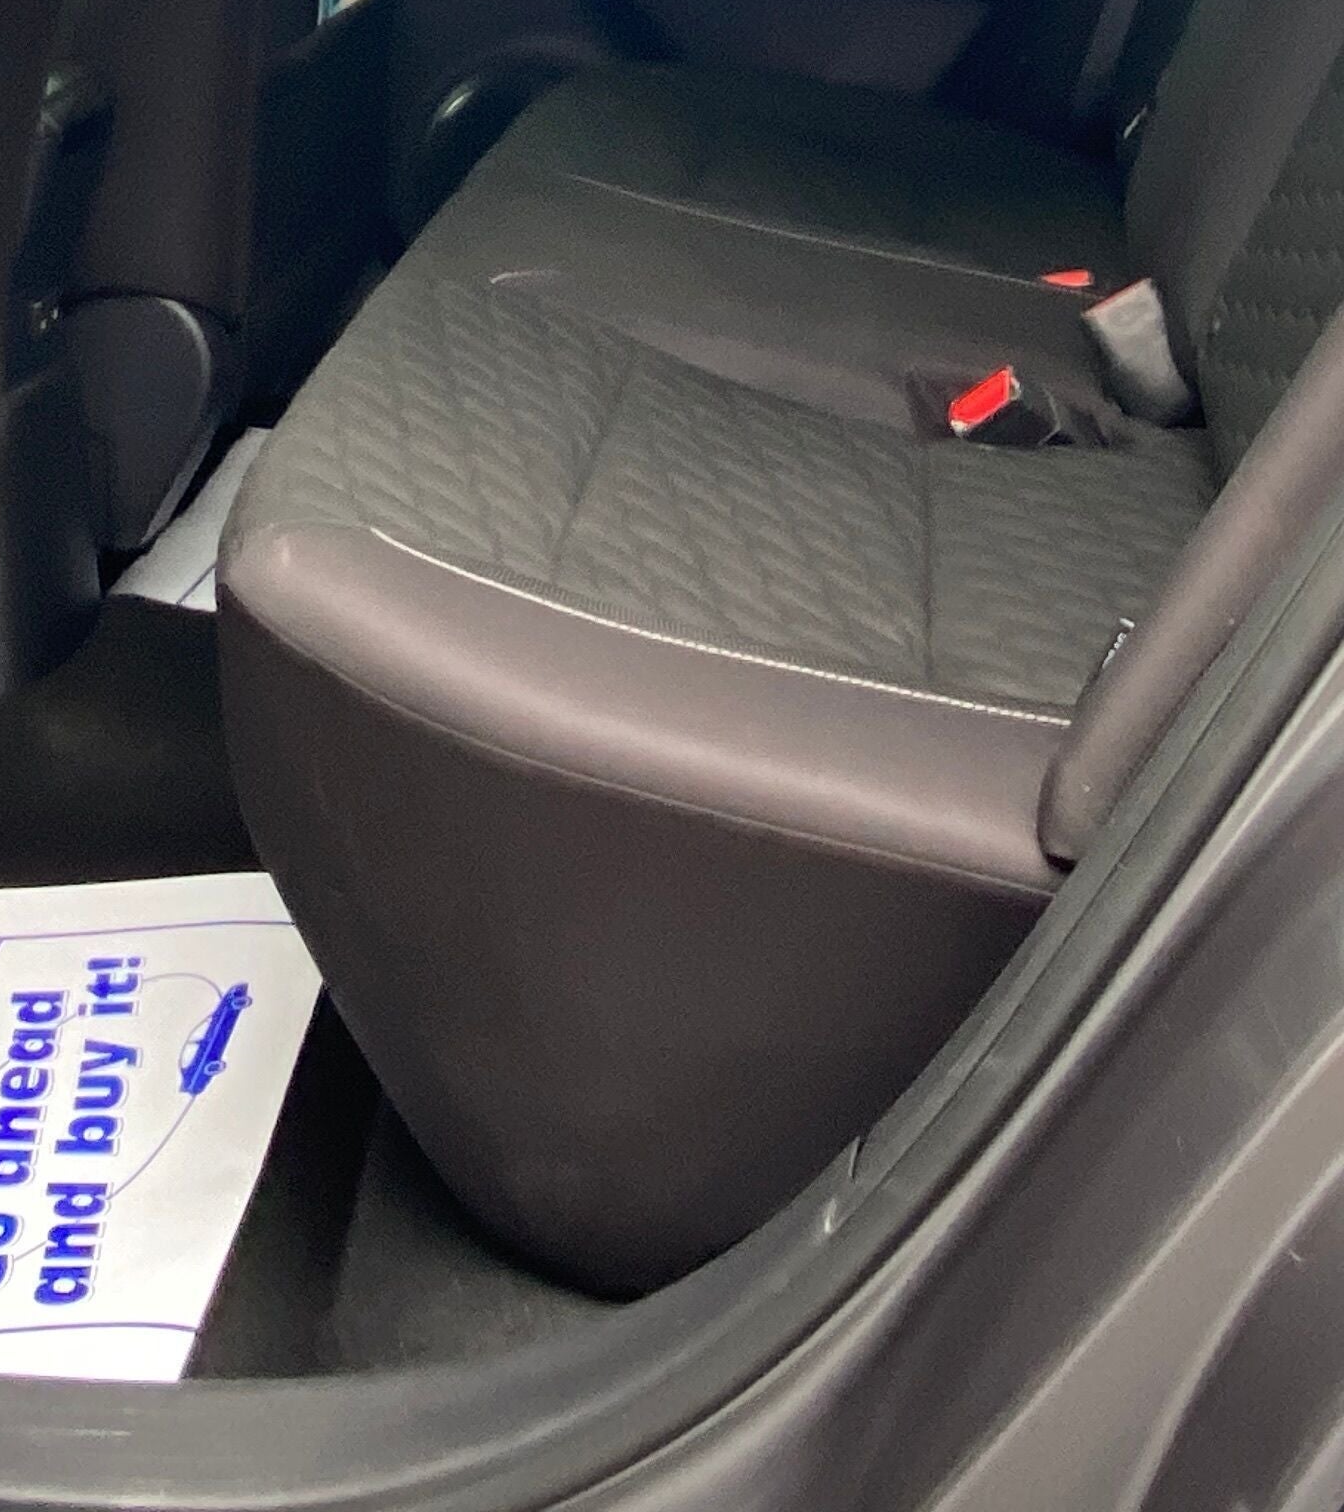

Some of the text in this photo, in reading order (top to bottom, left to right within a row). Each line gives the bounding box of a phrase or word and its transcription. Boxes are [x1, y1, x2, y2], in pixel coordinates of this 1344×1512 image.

[34, 955, 143, 1306] and buy it!
